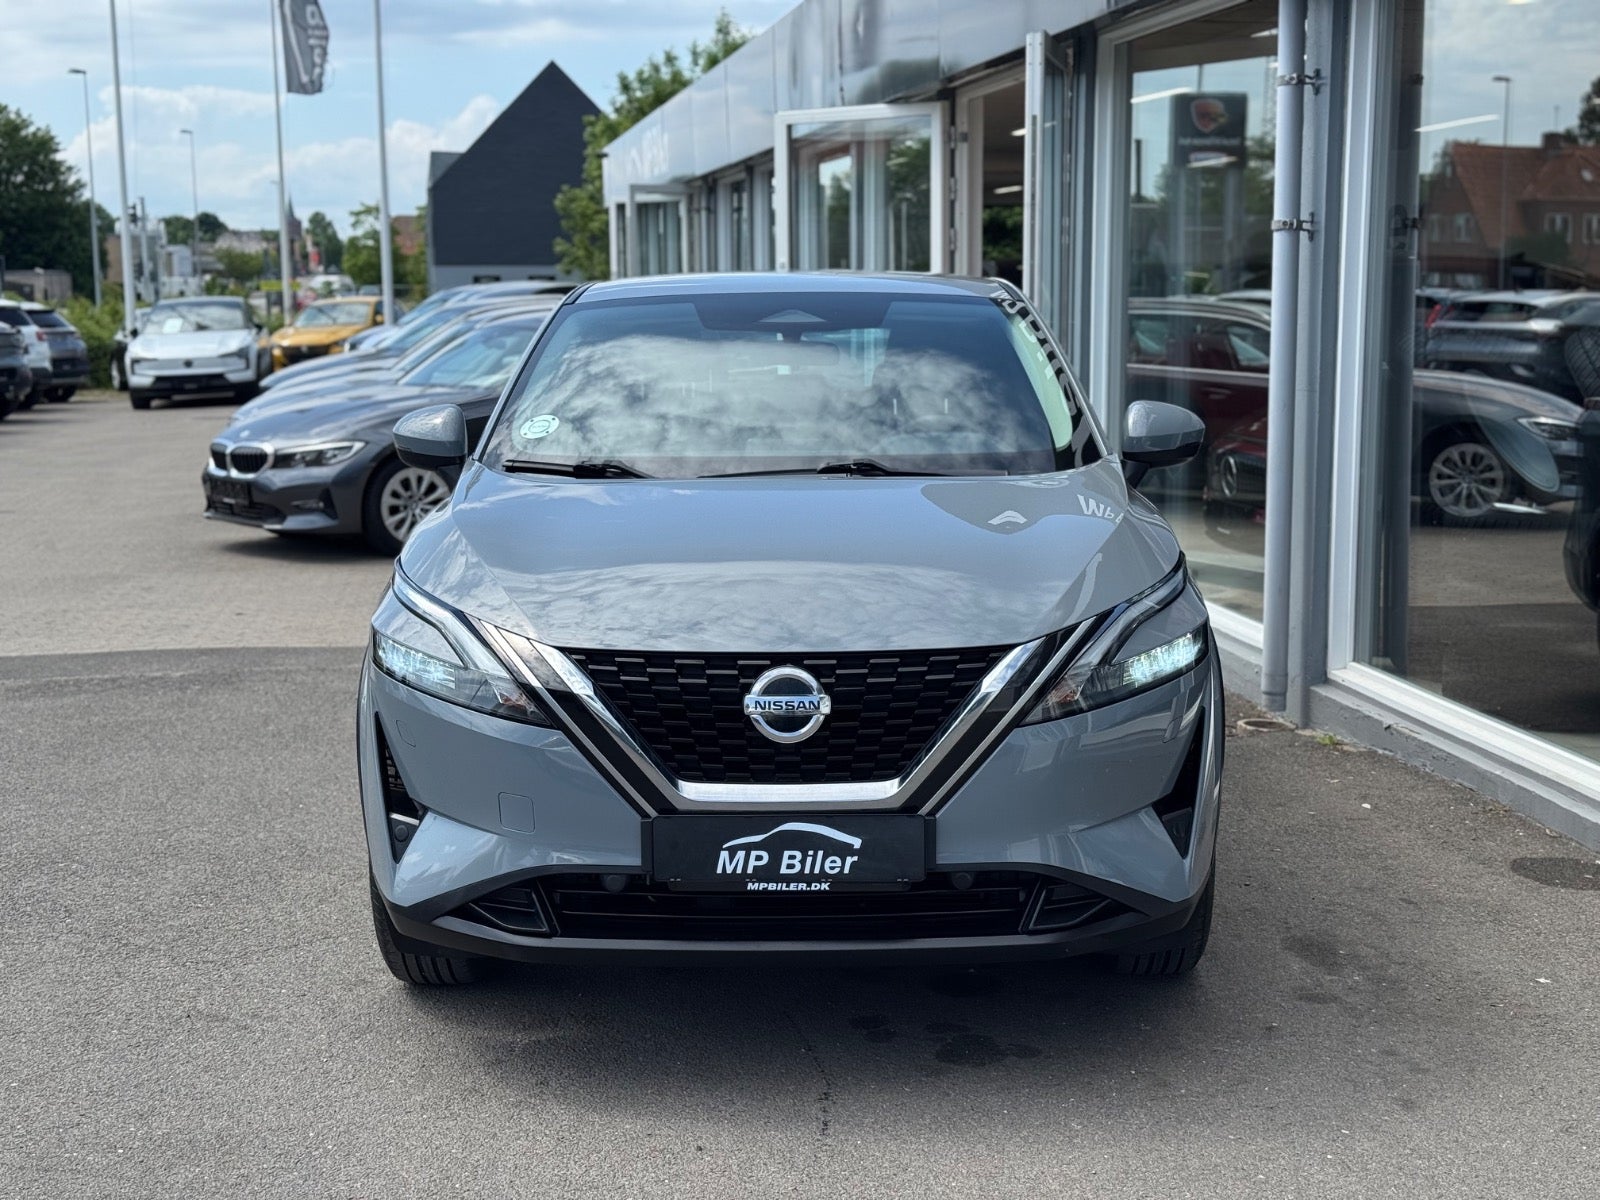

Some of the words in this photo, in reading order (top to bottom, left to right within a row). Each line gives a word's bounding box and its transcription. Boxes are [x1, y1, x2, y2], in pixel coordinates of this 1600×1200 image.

[754, 700, 820, 711] NISSAN
[716, 850, 769, 874] MP
[779, 850, 858, 874] Biler
[746, 882, 831, 891] MPBILER.DK
